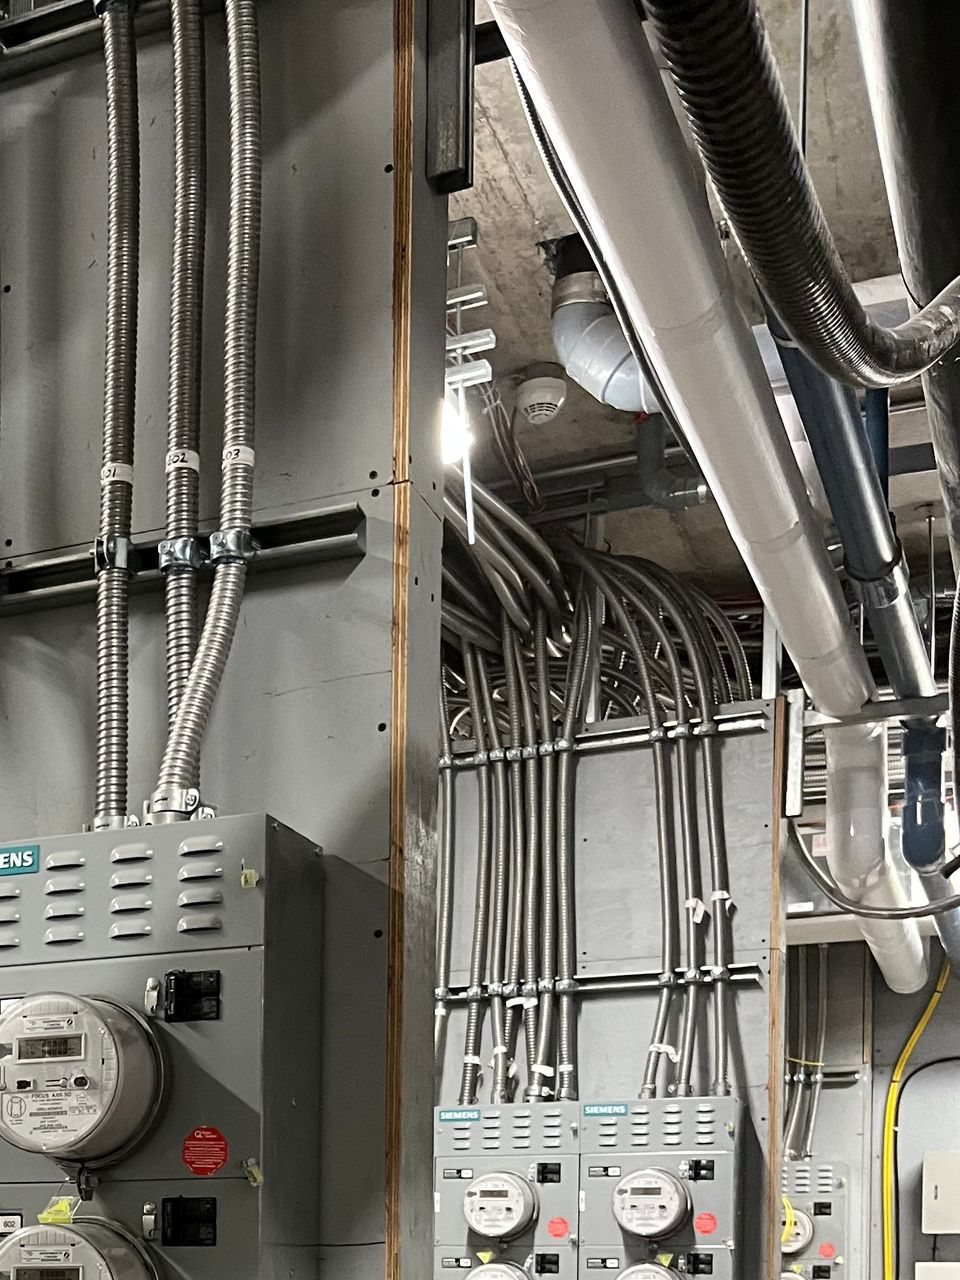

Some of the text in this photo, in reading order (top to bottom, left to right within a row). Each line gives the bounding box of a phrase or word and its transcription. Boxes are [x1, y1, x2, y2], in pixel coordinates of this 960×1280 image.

[585, 1105, 626, 1114] SIEMENS
[440, 1111, 479, 1120] SIEMENS
[3, 1220, 16, 1229] 602
